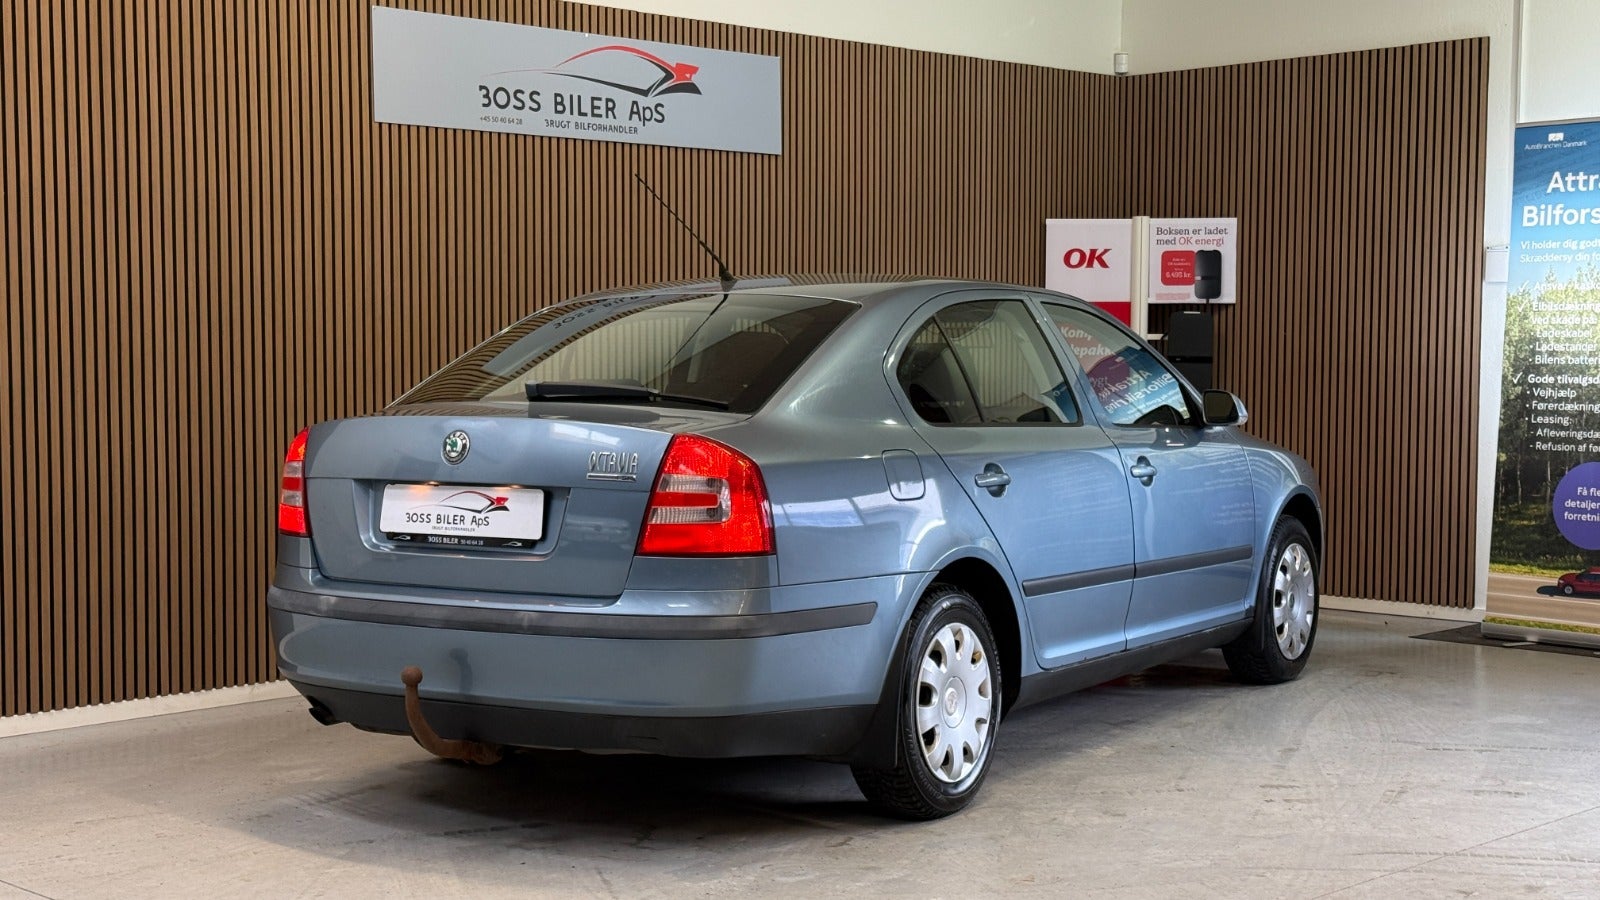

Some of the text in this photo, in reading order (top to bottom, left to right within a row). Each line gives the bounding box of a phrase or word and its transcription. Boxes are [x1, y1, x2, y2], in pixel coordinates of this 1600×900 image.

[554, 92, 616, 119] BILER
[628, 101, 665, 126] ApS
[575, 122, 638, 134] BILFORHANDLER
[1546, 170, 1600, 194] Attr
[1156, 226, 1190, 236] Boksen
[1204, 226, 1228, 235] ladet
[1156, 236, 1224, 247] med OK energi
[1521, 240, 1530, 249] Vi
[1531, 240, 1561, 249] holder
[1562, 239, 1577, 250] dig
[1063, 248, 1112, 269] OK
[1575, 252, 1590, 261] din
[1536, 329, 1592, 338] Ladeskabel
[1535, 342, 1598, 351] Ladestander
[1535, 354, 1566, 365] Bilens
[1527, 374, 1555, 384] Gode
[1532, 387, 1576, 399] Vejhjælp
[1532, 400, 1600, 413] Førerdækning
[1535, 441, 1576, 451] Refusion
[1577, 443, 1586, 452] af
[589, 450, 638, 473] OCTAVIA
[1577, 486, 1588, 496] Få
[436, 513, 465, 525] BILER
[470, 515, 490, 528] ApS
